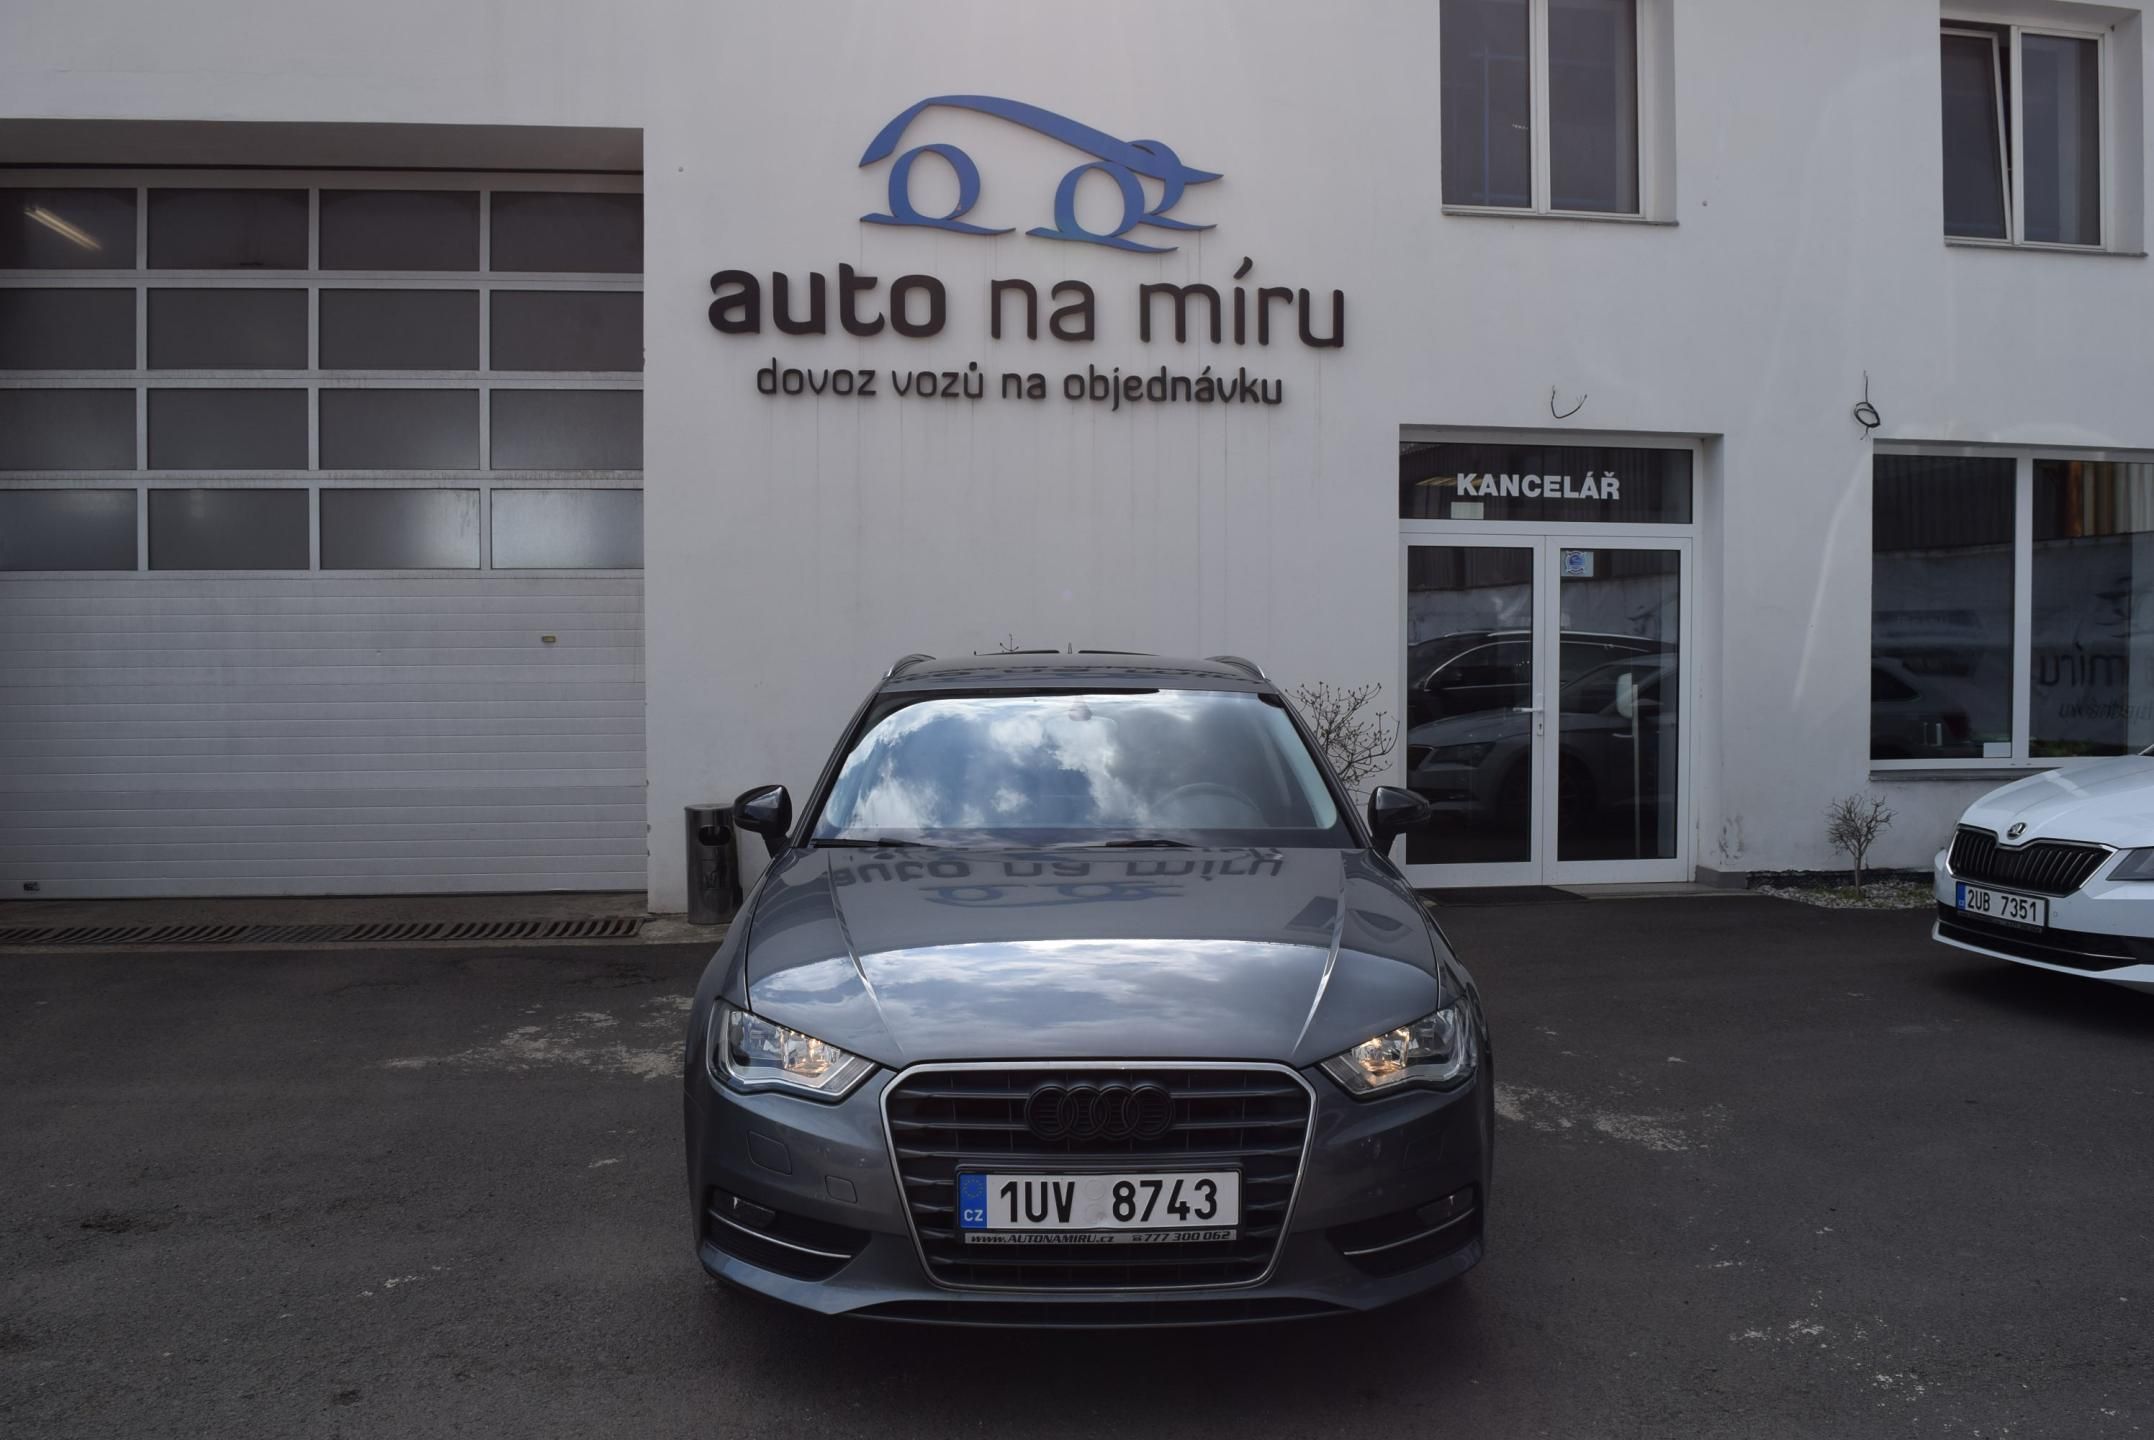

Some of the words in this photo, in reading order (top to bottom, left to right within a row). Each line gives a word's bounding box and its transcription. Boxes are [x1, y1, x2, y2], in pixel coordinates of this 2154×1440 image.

[708, 263, 946, 338] auto
[990, 278, 1095, 341] na
[1139, 256, 1344, 349] míru
[757, 358, 876, 397] dovoz
[891, 361, 983, 400] vozů
[1001, 371, 1046, 400] na
[1063, 364, 1282, 411] objednávku
[1456, 471, 1620, 500] KANCELÁŘ
[1967, 889, 1991, 912] 2UB
[2001, 895, 2036, 922] 7351
[963, 1210, 984, 1222] CZ
[1000, 1181, 1076, 1223] 1UV
[1112, 1179, 1218, 1222] 8743
[971, 1233, 1114, 1244] www.AUTONAMIRU.cz
[1143, 1233, 1169, 1242] 777
[1172, 1232, 1200, 1242] 300
[1202, 1231, 1231, 1241] 062
